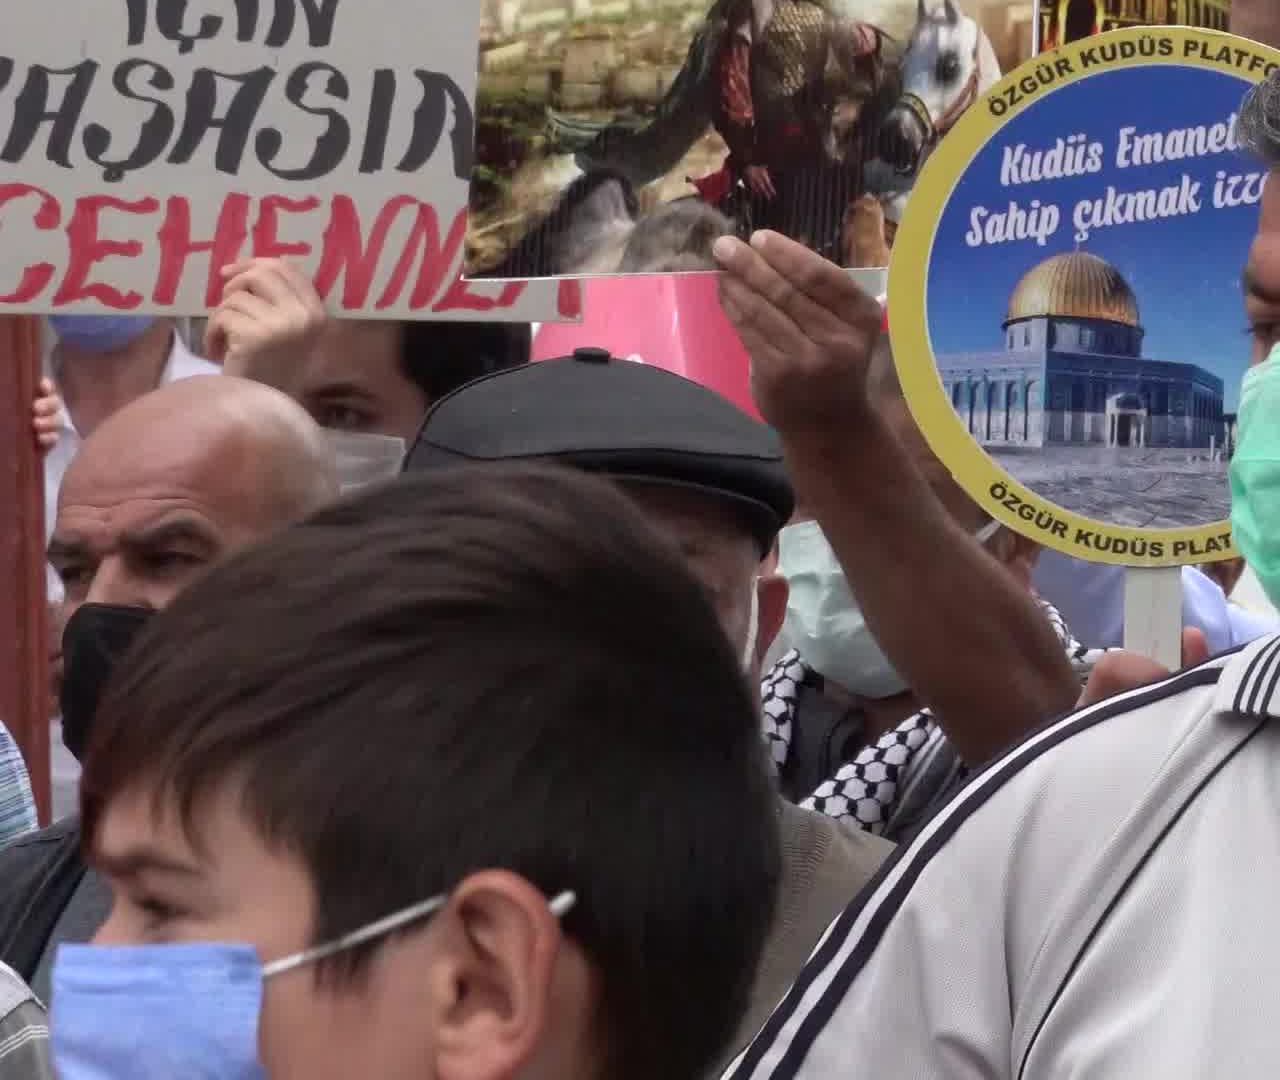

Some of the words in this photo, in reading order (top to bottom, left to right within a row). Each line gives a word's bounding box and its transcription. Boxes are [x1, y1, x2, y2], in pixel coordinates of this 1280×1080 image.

[988, 58, 1075, 118] ÖZGÜR
[1079, 37, 1174, 69] KUDÜS
[1000, 134, 1103, 187] Kudüs
[965, 200, 1060, 248] Sahip
[989, 481, 1069, 539] ÖZGÜR
[1074, 528, 1164, 558] KUDÜS
